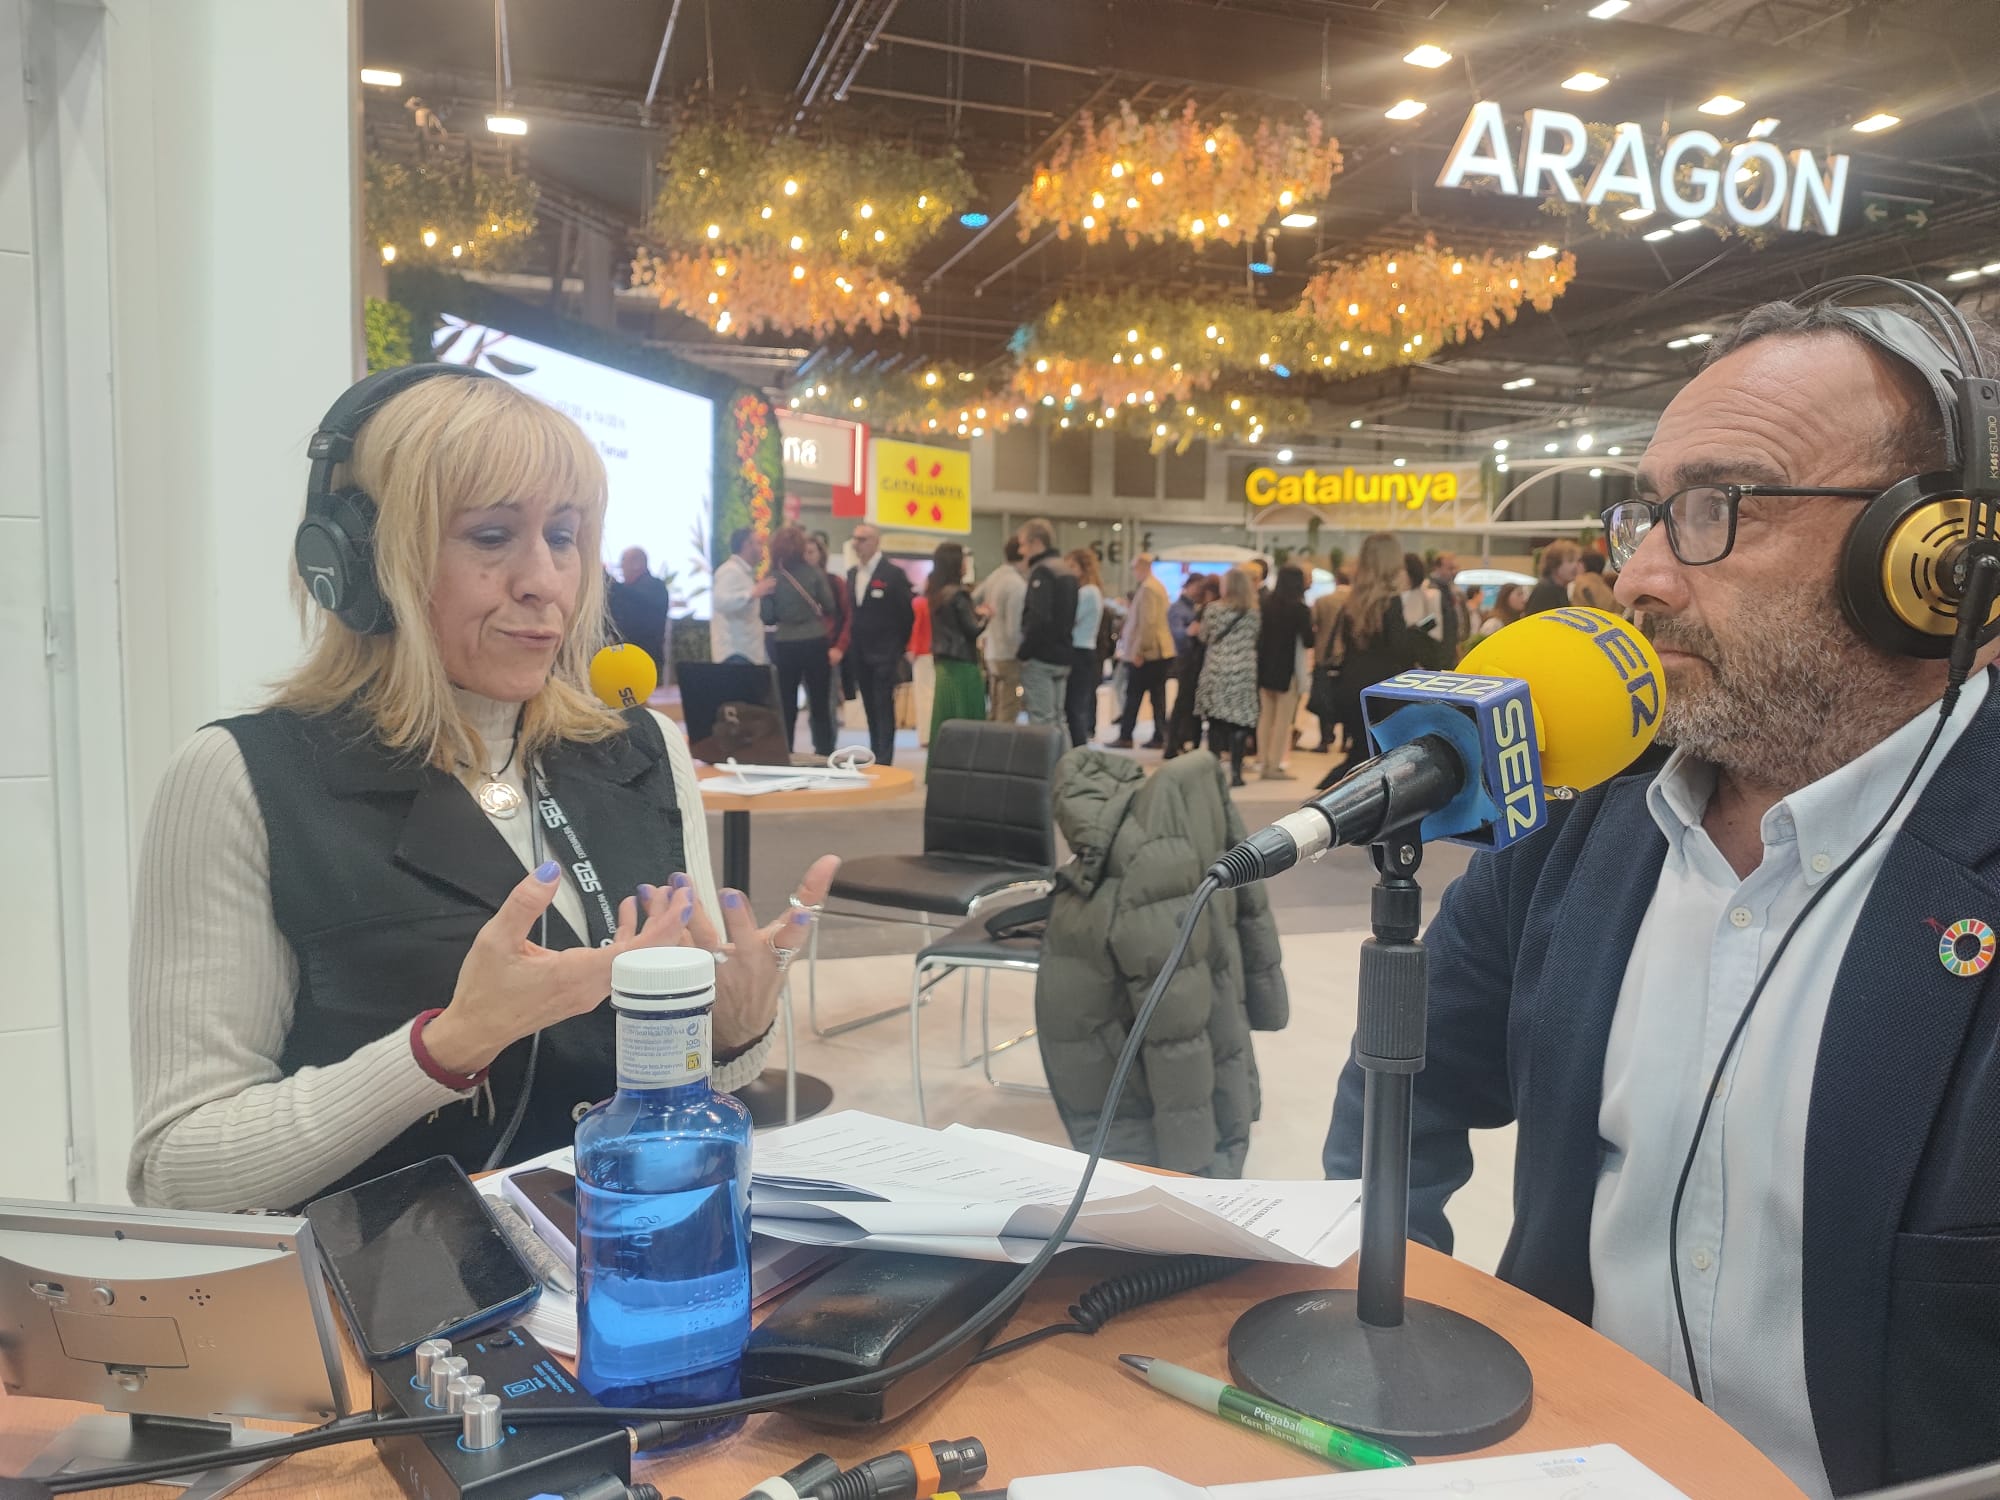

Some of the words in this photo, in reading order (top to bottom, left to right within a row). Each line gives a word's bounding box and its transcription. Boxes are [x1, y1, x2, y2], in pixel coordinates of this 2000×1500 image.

[1436, 100, 1850, 236] ARAGÓN
[1245, 466, 1458, 510] Catalunya
[1380, 674, 1504, 695] SER
[1540, 607, 1659, 738] SER
[618, 687, 638, 708] SE
[1492, 698, 1538, 838] SER
[538, 797, 568, 829] SER
[572, 860, 602, 893] SER
[1240, 1413, 1263, 1432] Kern
[1253, 1406, 1315, 1439] Pregabalina
